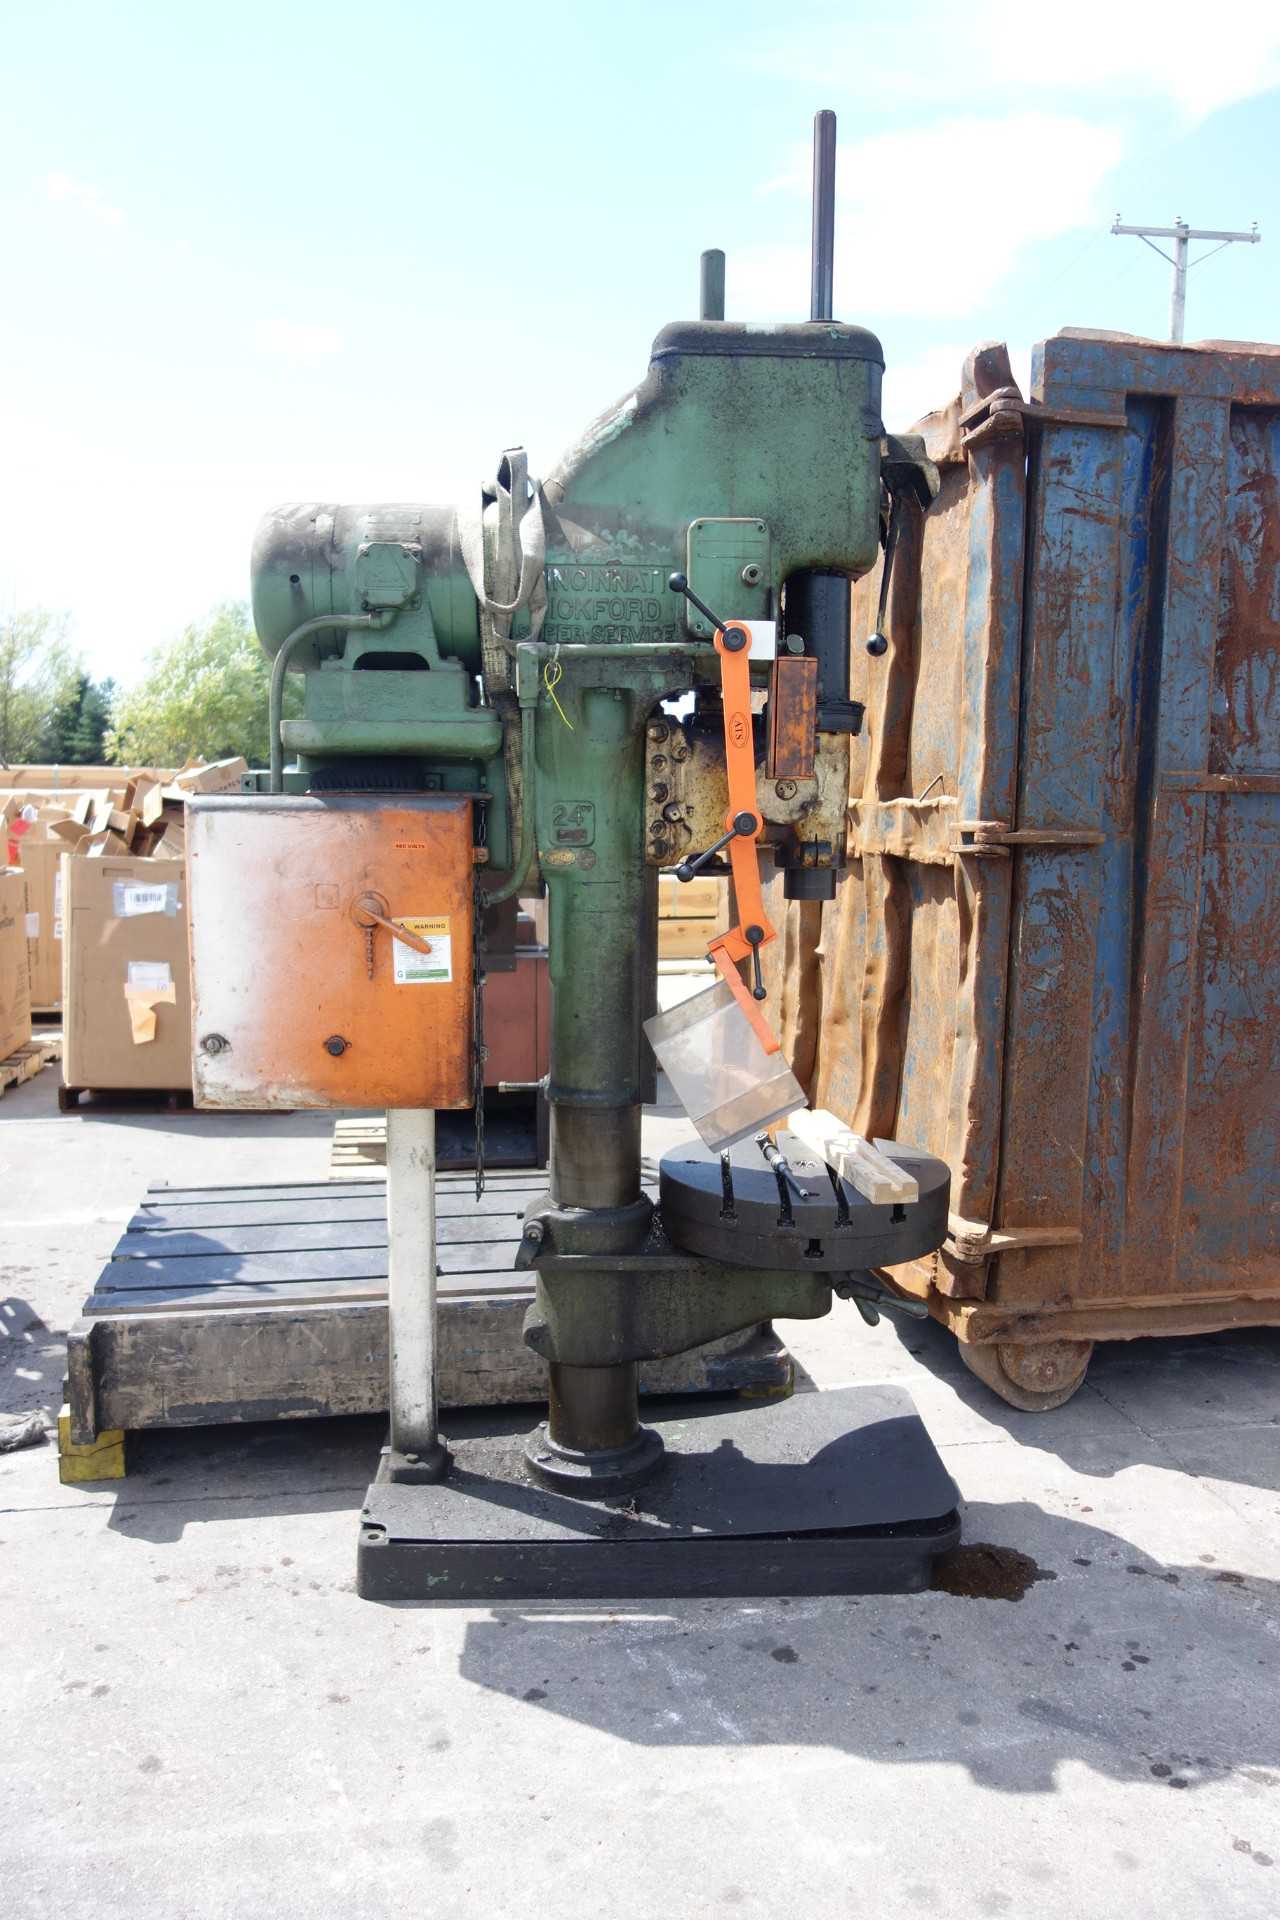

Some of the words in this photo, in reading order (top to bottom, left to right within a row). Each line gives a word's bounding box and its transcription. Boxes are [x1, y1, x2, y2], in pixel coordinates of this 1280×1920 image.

[543, 567, 667, 593] INCINNATI
[547, 597, 662, 623] ICKFORD
[517, 623, 585, 643] SPER
